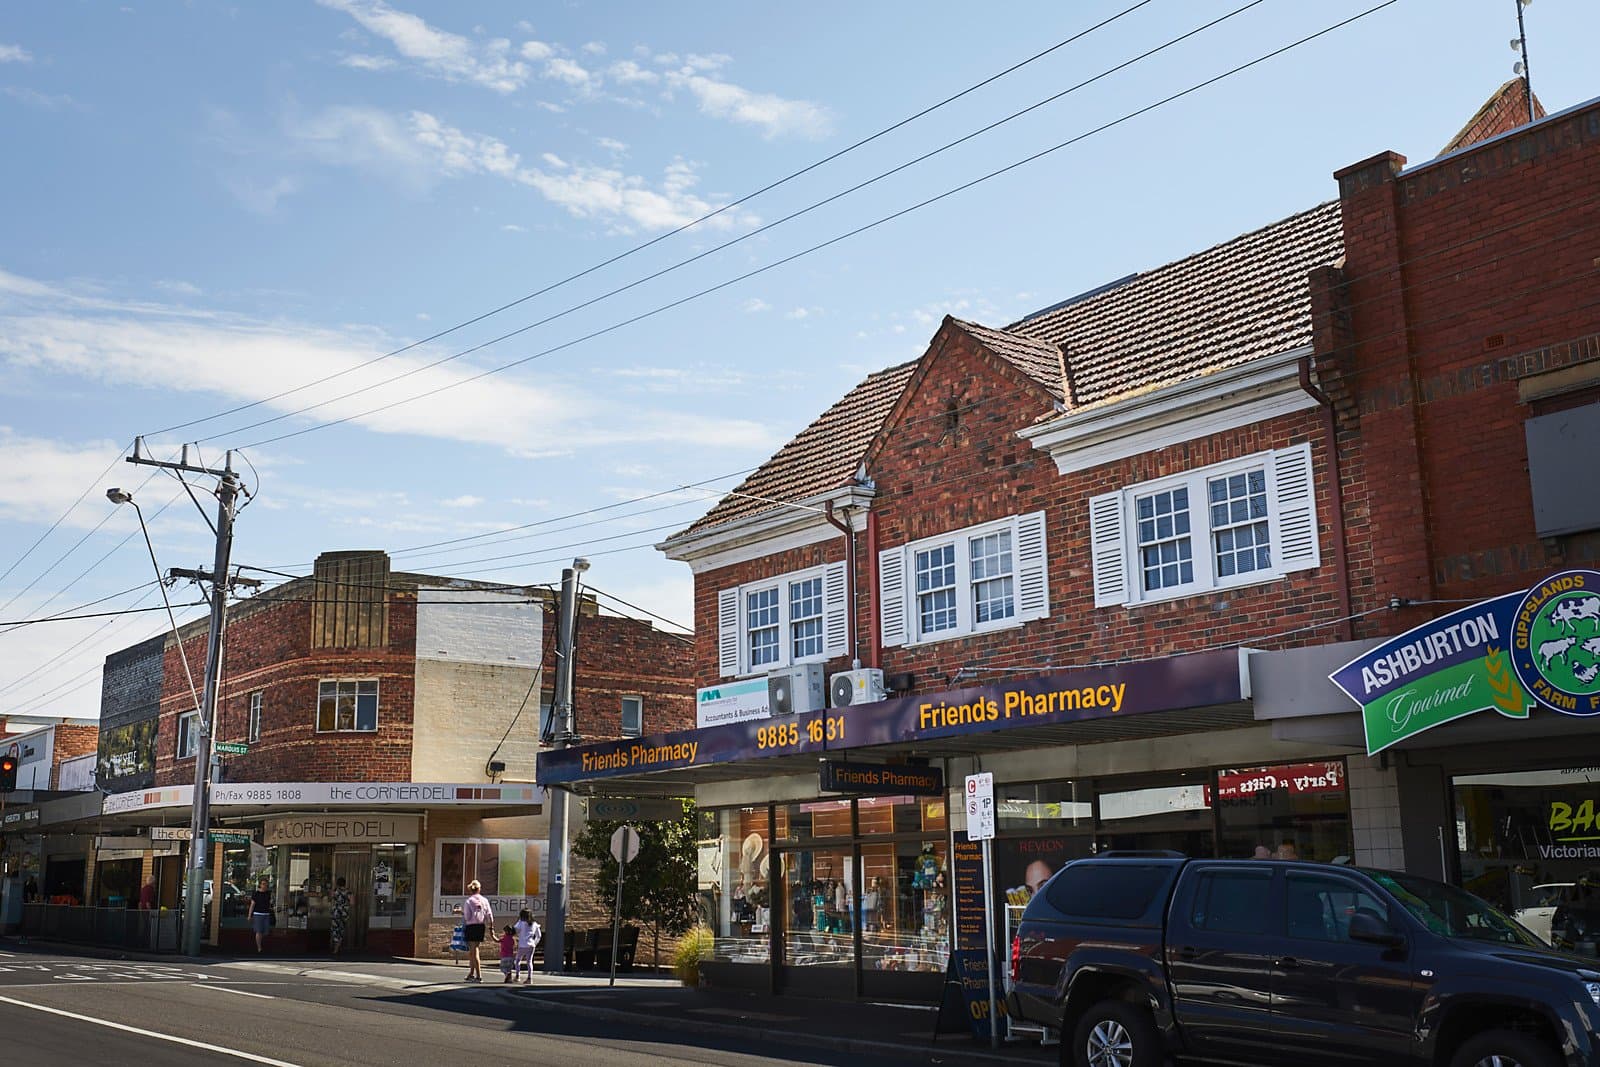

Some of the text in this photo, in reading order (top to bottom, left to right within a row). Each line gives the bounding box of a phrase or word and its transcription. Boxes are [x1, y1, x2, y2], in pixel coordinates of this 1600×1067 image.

[1516, 575, 1585, 649] GIPPSLANDS
[1361, 612, 1500, 695] ASHBURTON
[1386, 673, 1476, 733] Gourmet
[1532, 679, 1577, 710] FARM
[704, 711, 734, 722] Accountants
[739, 707, 761, 717] Business
[919, 682, 1126, 729] Friends Pharmacy
[757, 715, 846, 749] 9885 1631
[216, 744, 240, 753] MARQUIS
[581, 741, 698, 772] Friends Pharmacy
[835, 768, 937, 790] Friends Pharmacy
[215, 790, 301, 800] Ph/Fax 9885 1808
[330, 786, 455, 800] the CORNER DELI
[982, 797, 992, 809] 1P
[1549, 799, 1600, 834] BA
[157, 828, 175, 839] the
[284, 821, 349, 839] CORNER
[352, 820, 395, 838] DELI
[955, 841, 978, 851] Friends
[1019, 840, 1065, 851] REVLON
[955, 852, 983, 862] Pharmac
[970, 1000, 1008, 1021] OPN
